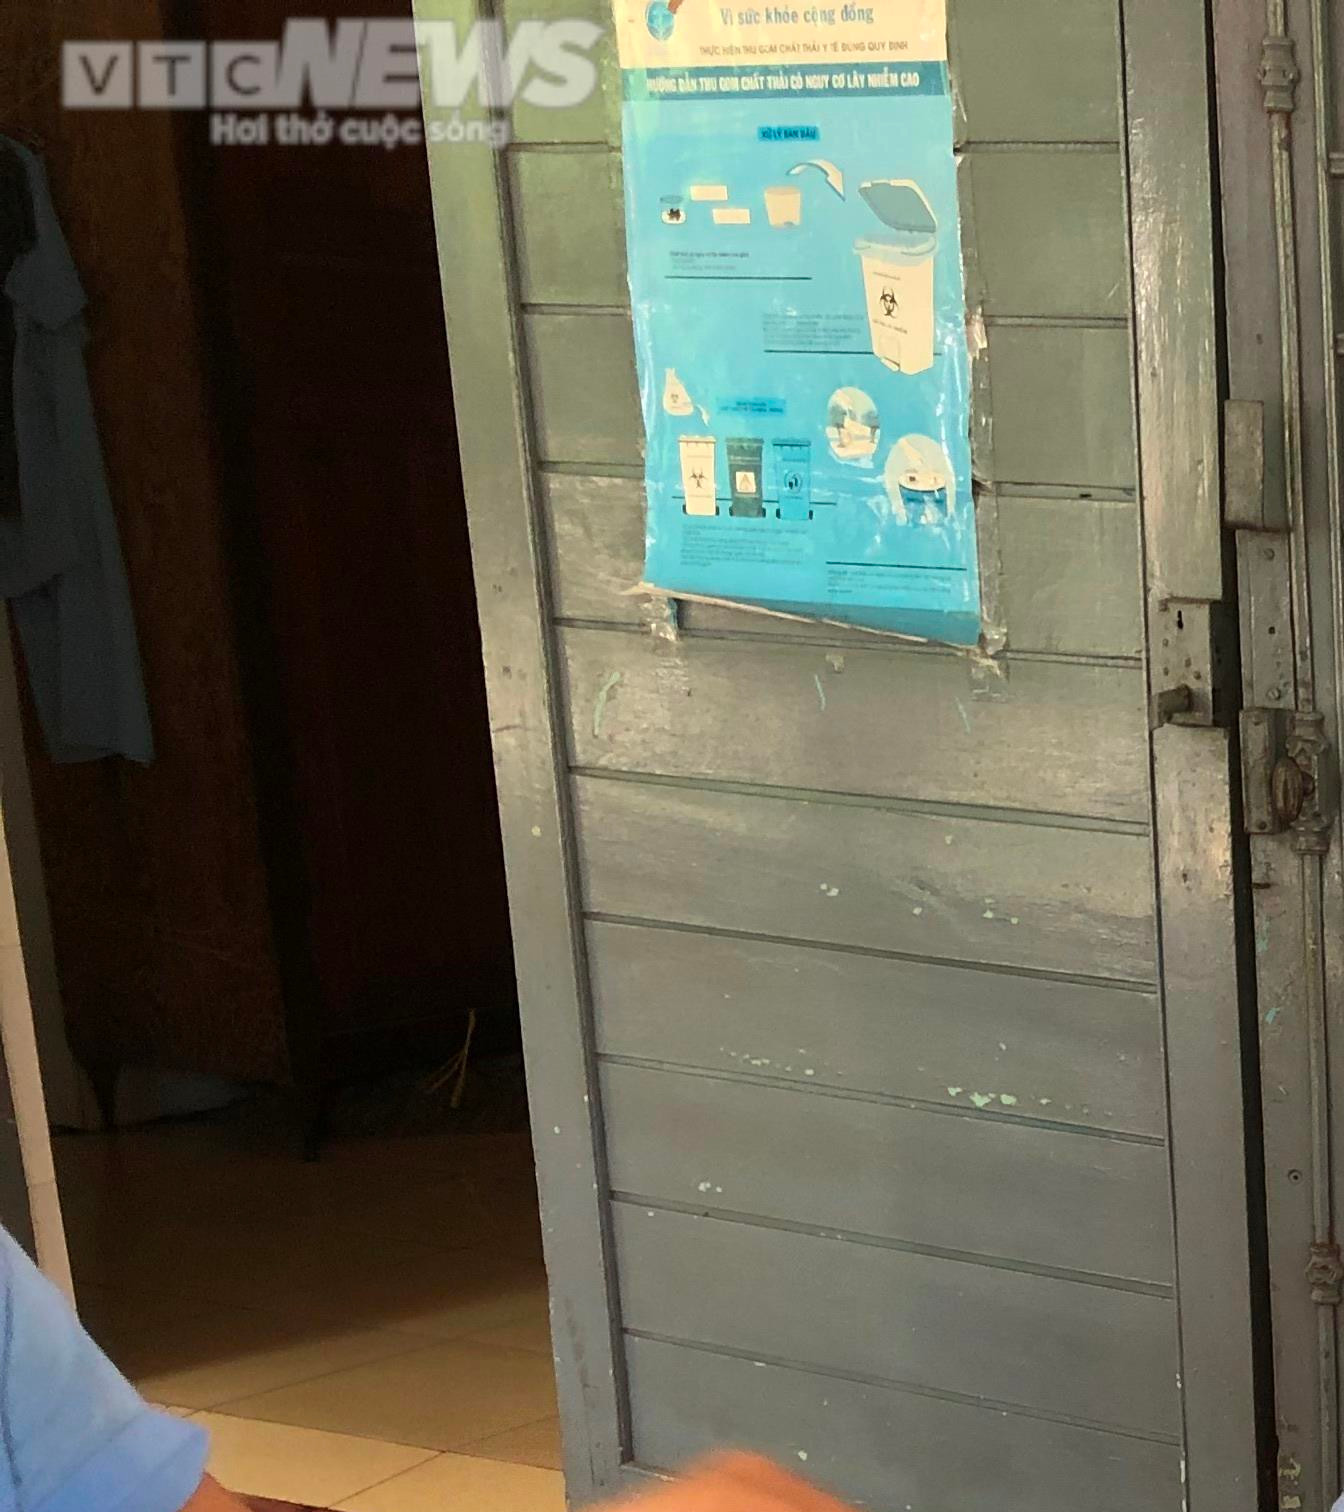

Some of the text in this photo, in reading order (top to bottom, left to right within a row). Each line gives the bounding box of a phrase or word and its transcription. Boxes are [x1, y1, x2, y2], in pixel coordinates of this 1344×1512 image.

[738, 7, 760, 26] sức
[765, 5, 799, 25] khỏe
[803, 6, 836, 28] cộng
[841, 2, 874, 25] đồng
[867, 41, 887, 52] QUY
[899, 72, 920, 87] CAO
